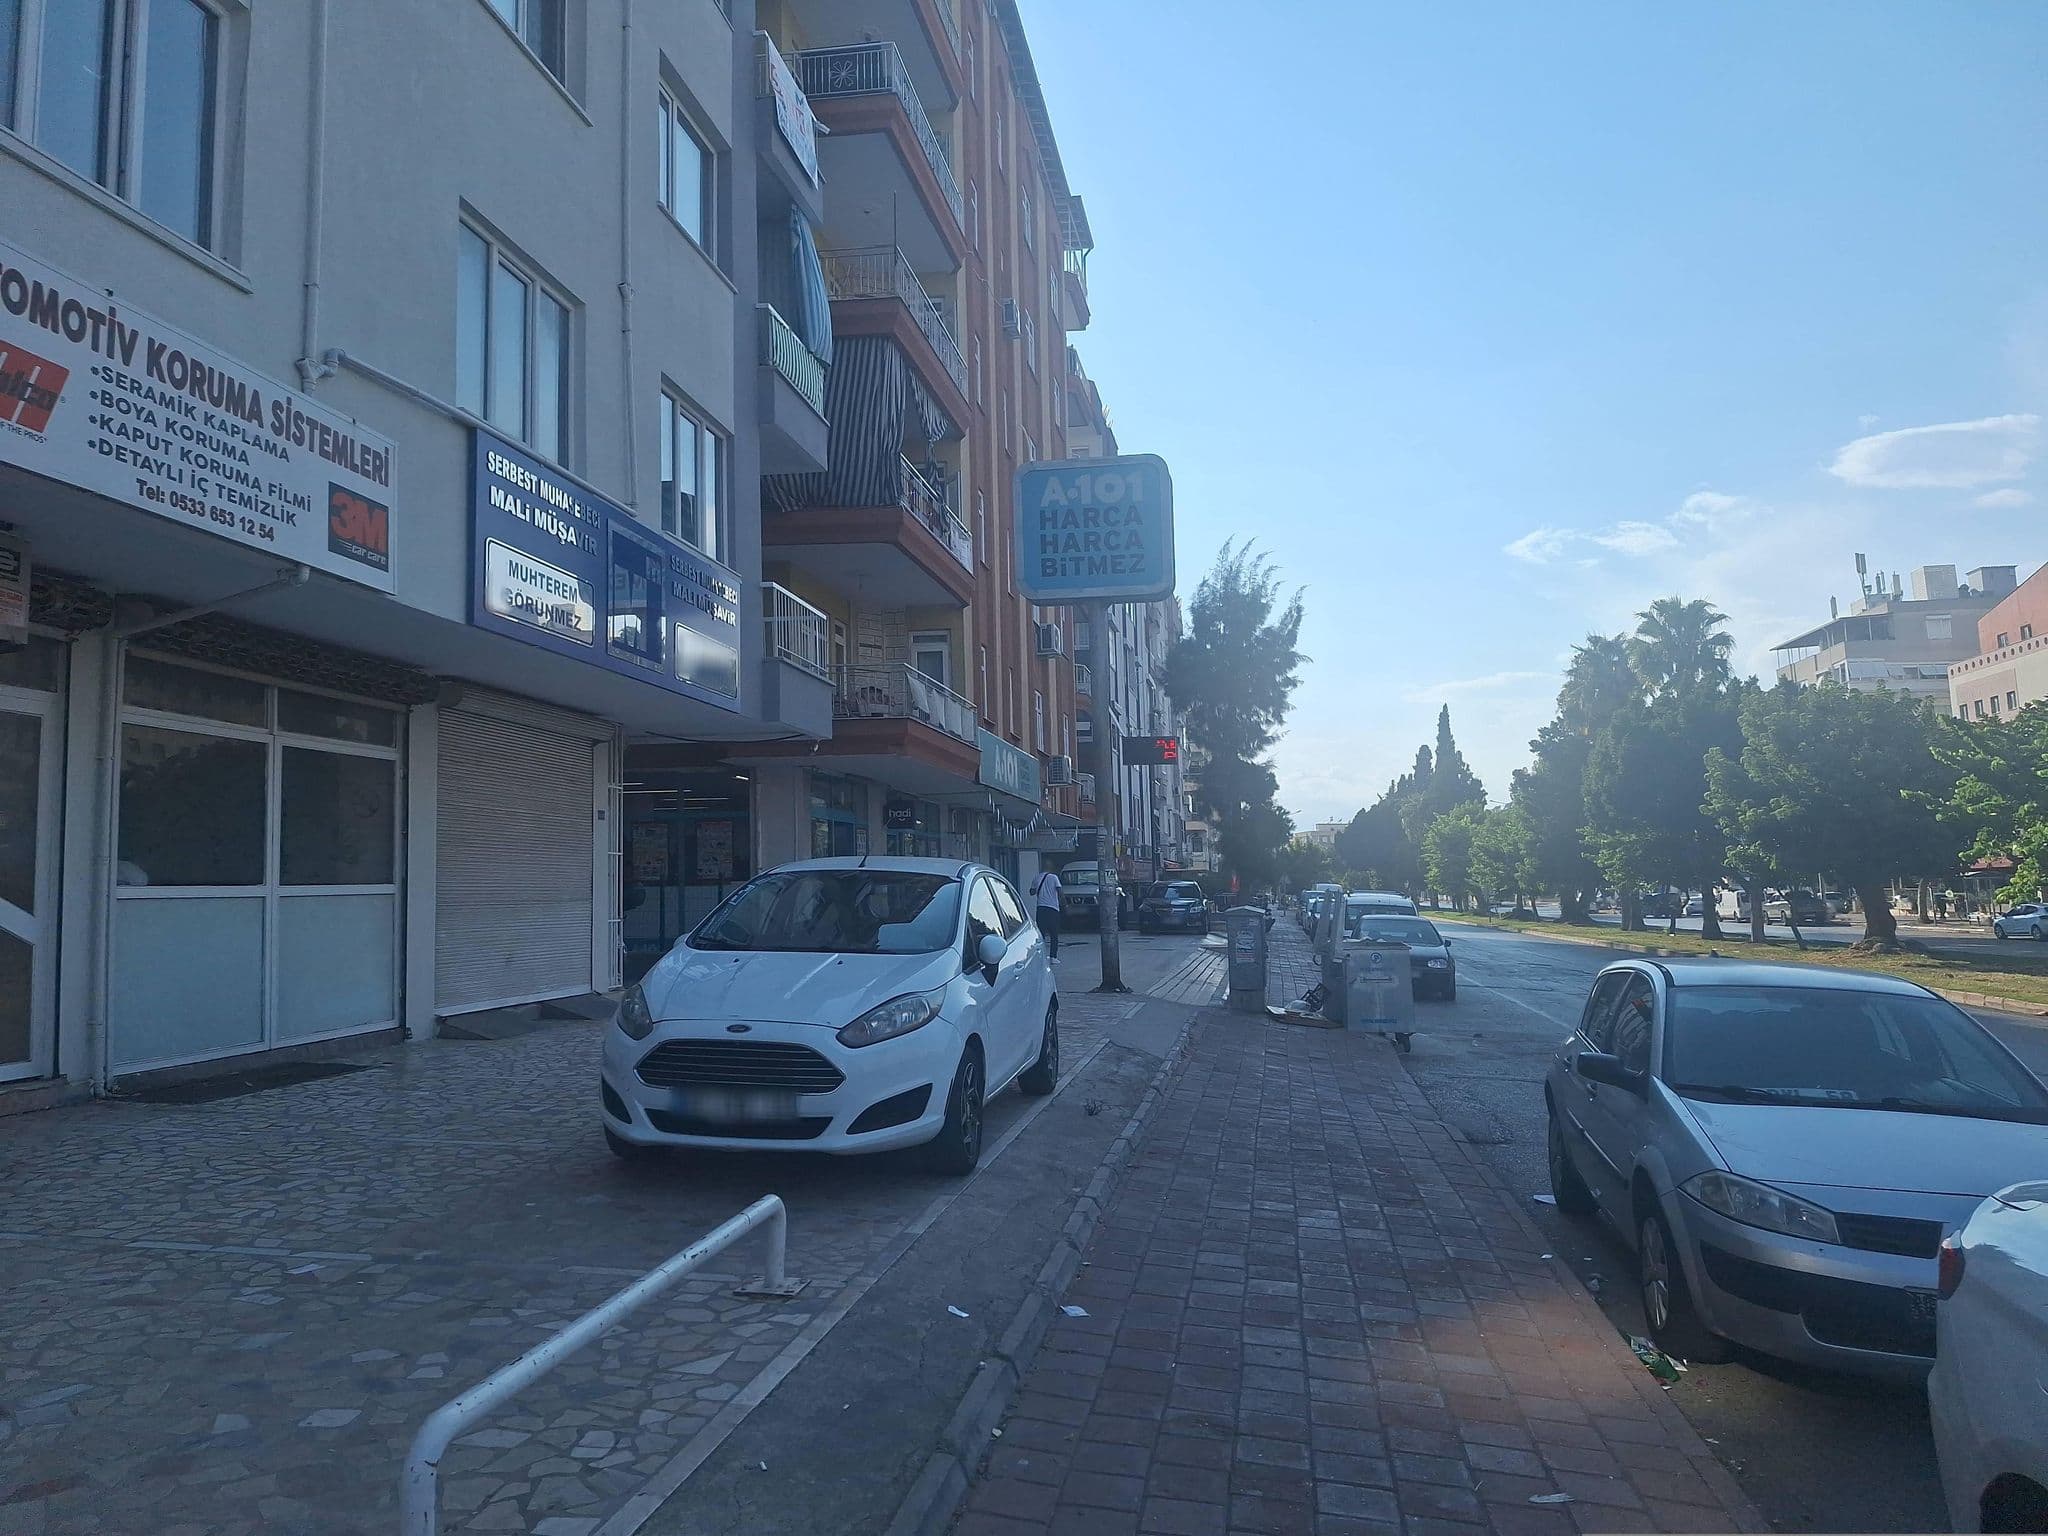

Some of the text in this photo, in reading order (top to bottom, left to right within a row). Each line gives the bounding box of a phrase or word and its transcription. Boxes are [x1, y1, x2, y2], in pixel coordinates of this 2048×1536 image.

[0, 262, 139, 367] OMOTİV
[146, 337, 265, 430] KORUMA
[271, 397, 391, 488] SİSTEMLERİ
[99, 366, 198, 422] SERAMİK
[204, 412, 291, 464] KAPLAMA
[100, 392, 251, 467] BOYA KORUMA
[97, 438, 298, 528] DETAYLI İÇ TEMİZLİK
[99, 413, 313, 513] KAPUT KORUMA FİLMİ
[487, 450, 538, 494] SERBEST
[136, 477, 276, 542] Tel: 0533 653 12 54
[331, 491, 388, 553] 3M
[534, 507, 599, 557] MÜŞAVİR
[1039, 504, 1144, 531] HARCA
[1040, 528, 1145, 555] HARCA
[1040, 553, 1146, 578] BİTMEZ
[507, 559, 578, 605] MUHTEREM
[671, 554, 700, 585] SERBEST
[504, 587, 582, 632] GÖRÜNMEZ
